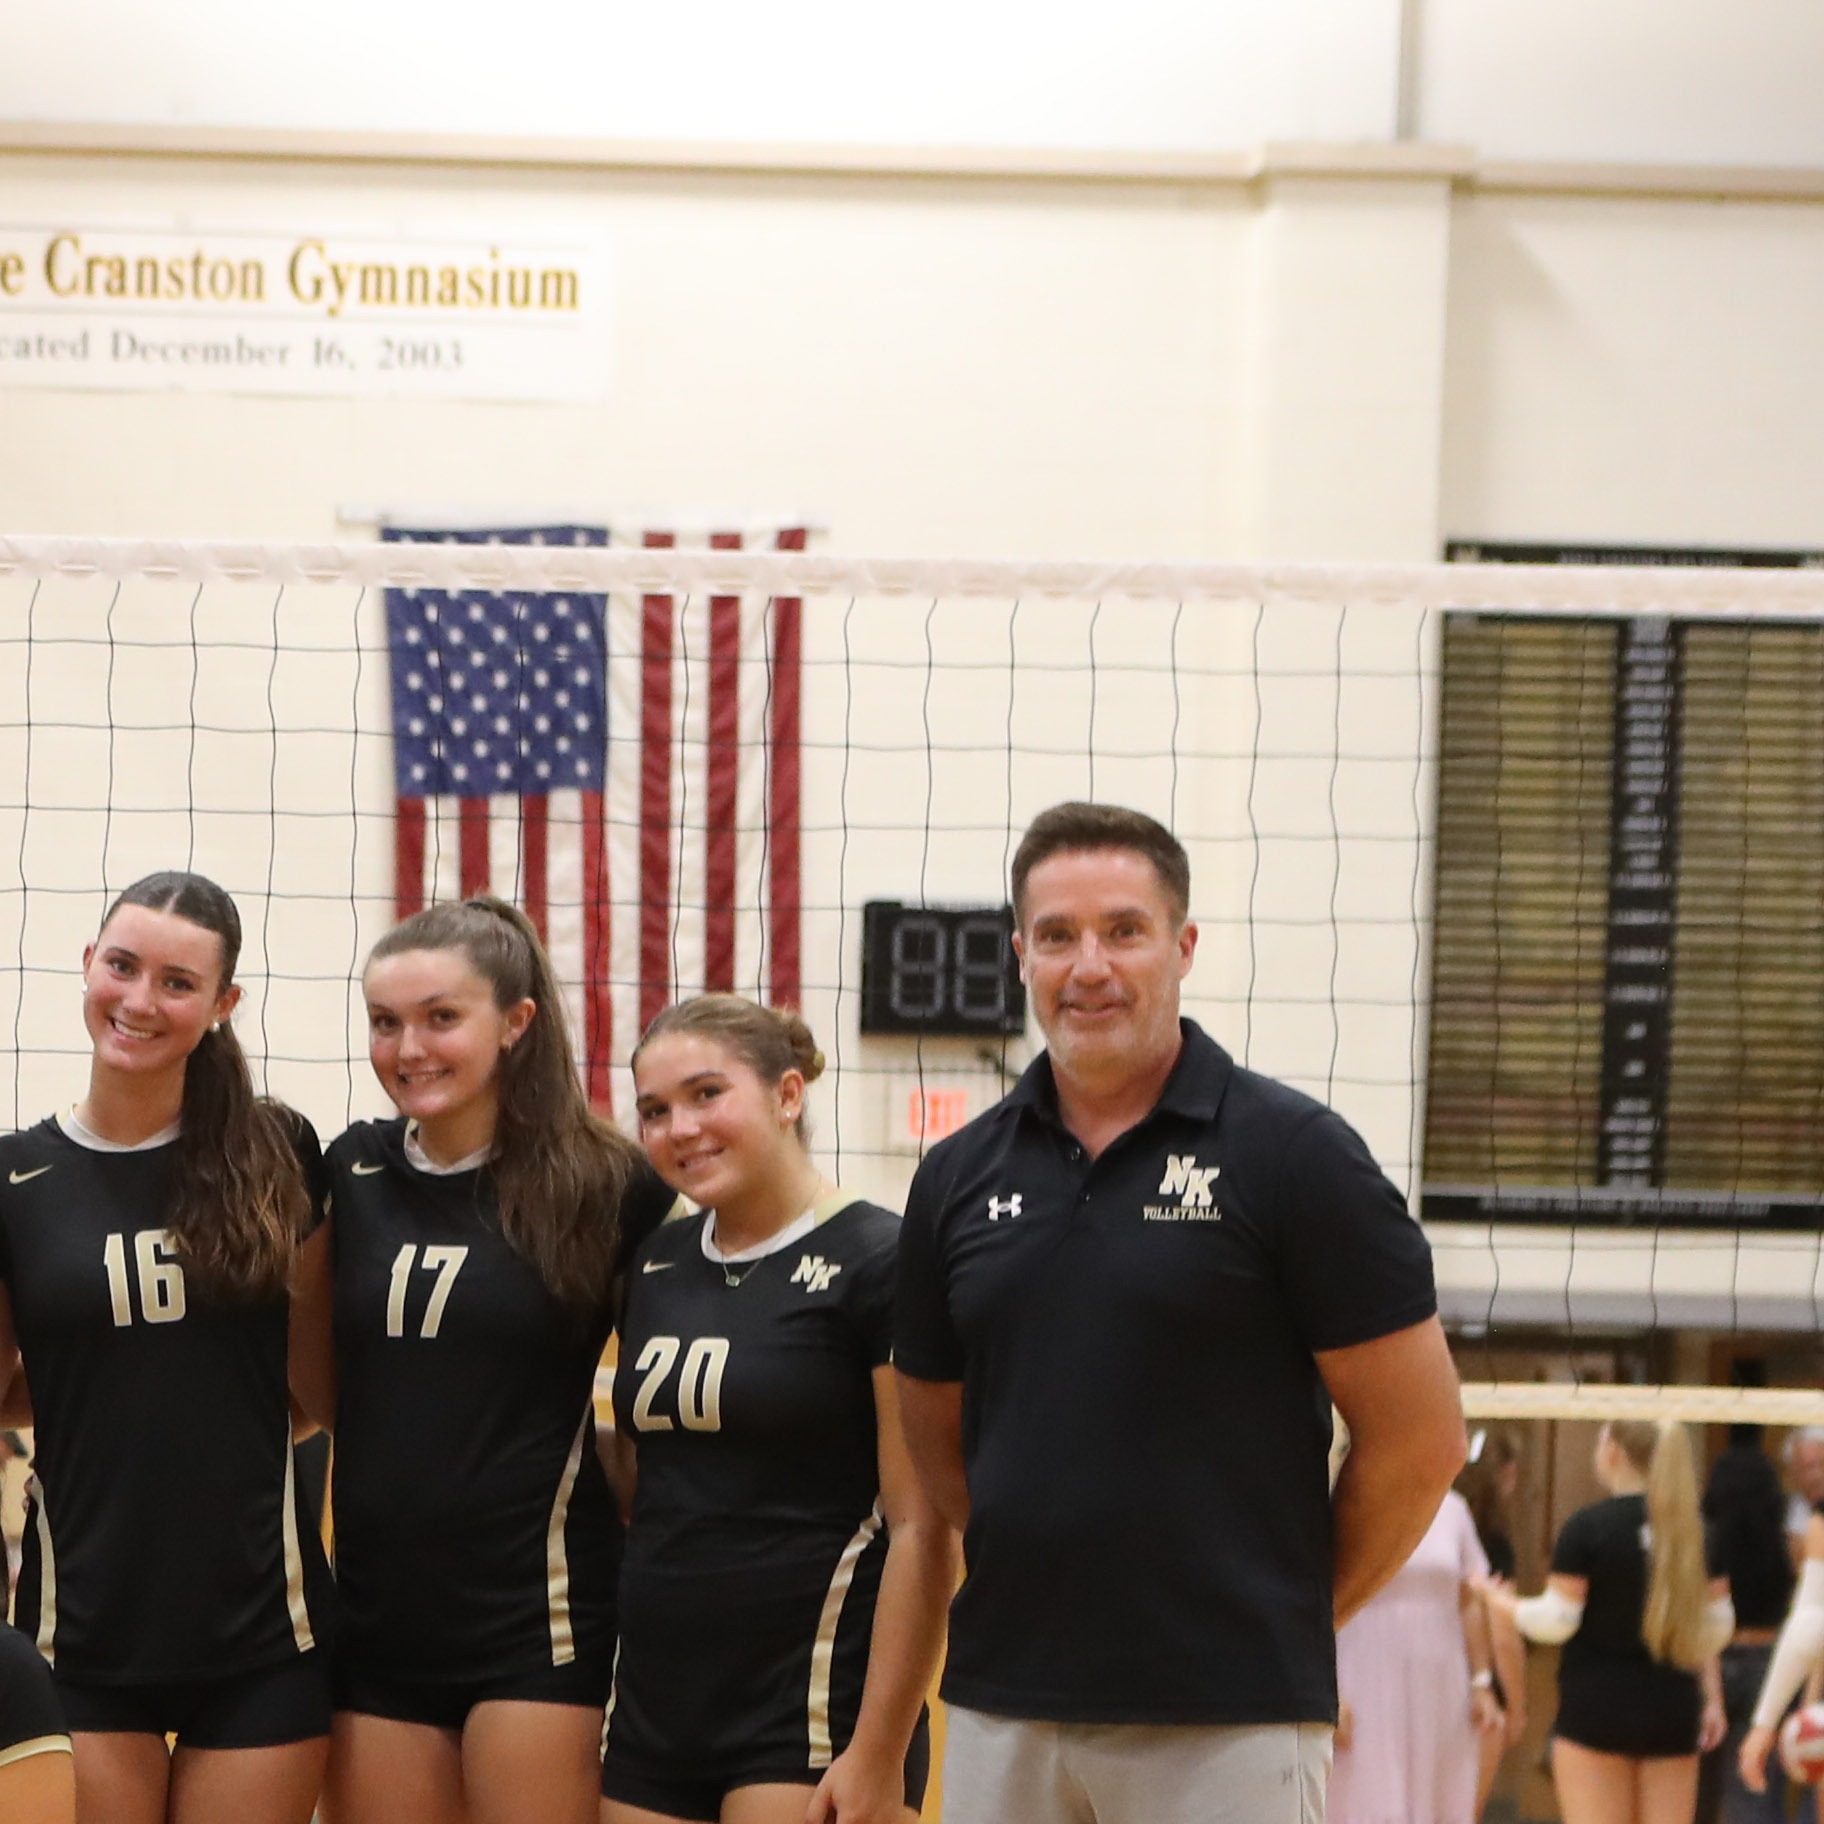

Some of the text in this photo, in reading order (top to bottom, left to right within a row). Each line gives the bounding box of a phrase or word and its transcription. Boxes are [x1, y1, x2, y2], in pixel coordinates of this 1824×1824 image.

[43, 234, 266, 303] Cranston
[287, 238, 582, 318] Gymnasium
[111, 330, 291, 367] December
[1143, 1205, 1222, 1221] VOLLEYBALL
[1159, 1154, 1221, 1206] NK
[103, 1228, 187, 1328] 16
[386, 1243, 469, 1339] 17
[790, 1254, 842, 1293] NK
[633, 1336, 730, 1432] 20
